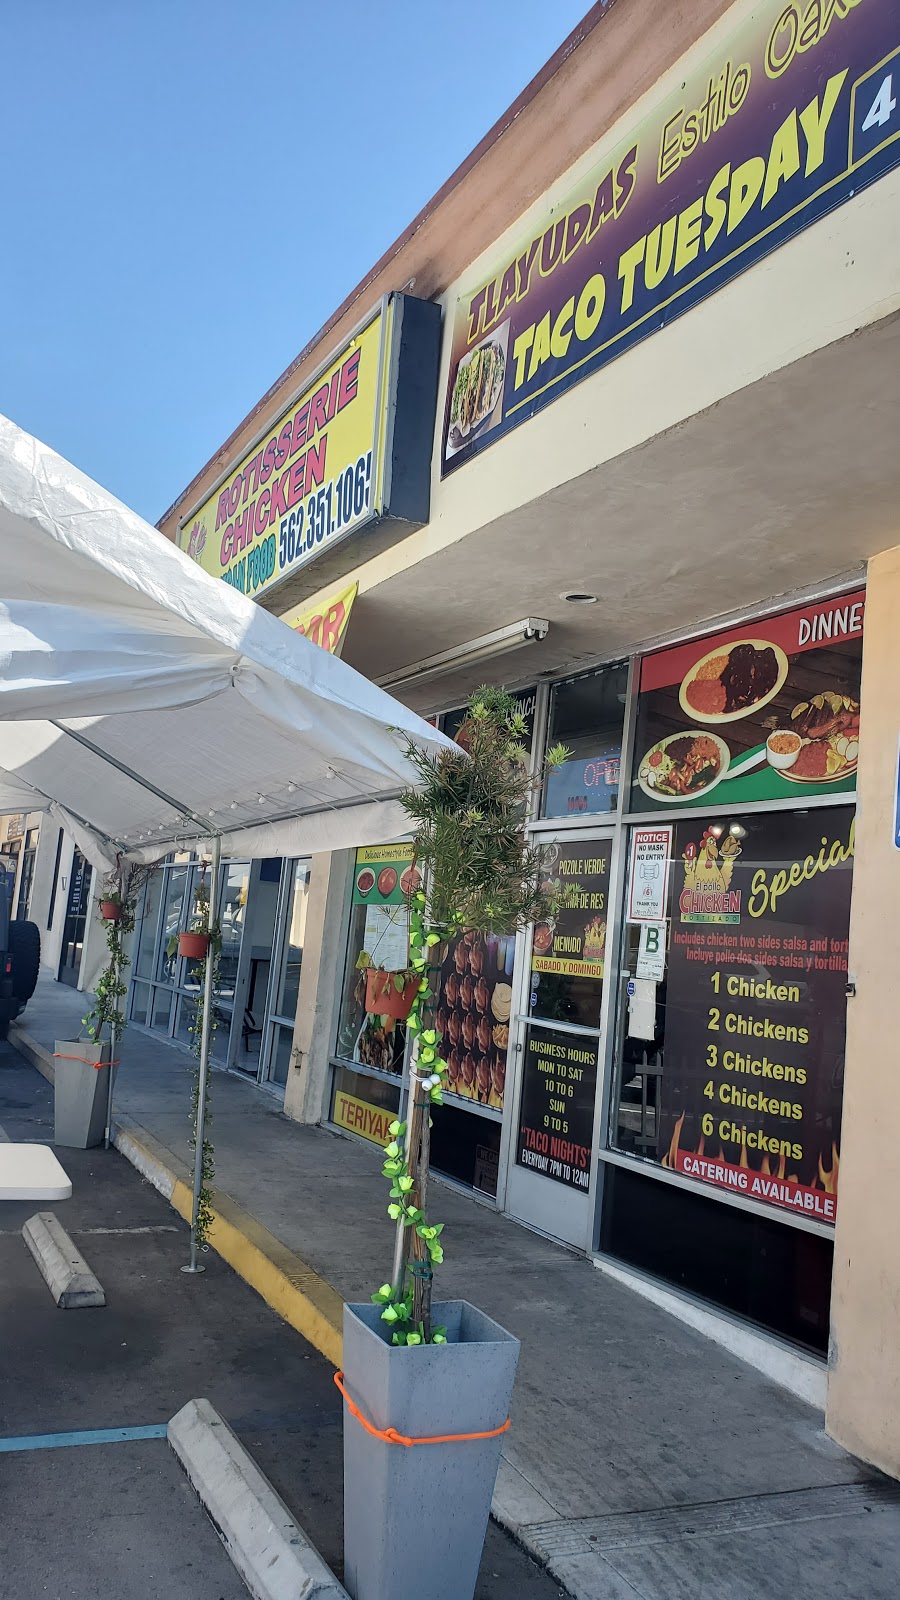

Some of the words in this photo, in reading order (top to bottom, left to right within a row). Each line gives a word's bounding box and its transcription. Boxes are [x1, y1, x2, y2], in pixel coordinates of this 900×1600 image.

[467, 144, 638, 345] TLAYUDAS
[657, 57, 751, 183] Estilo
[513, 273, 606, 391] TACO
[617, 68, 849, 314] TUESDAY
[215, 346, 362, 533] ROTISSERIE
[220, 432, 328, 567] CHICKEN
[246, 533, 275, 594] FOOD
[798, 602, 866, 646] DINNE
[637, 833, 668, 842] NOTICE
[558, 859, 583, 876] POZOLE
[584, 858, 606, 875] VERDE
[645, 853, 665, 861] ENTRY
[580, 893, 590, 908] DE
[590, 893, 604, 909] RES
[679, 888, 742, 914] CHICKEN
[553, 937, 582, 954] MENUDO
[645, 927, 659, 953] B
[674, 931, 705, 945] Includes
[706, 932, 738, 947] chicken
[740, 935, 756, 948] two
[757, 935, 781, 950] sides
[782, 936, 807, 951] salsa
[810, 937, 828, 952] and
[535, 959, 561, 971] SABADO
[563, 962, 567, 972] Y
[568, 962, 601, 976] DOMINGO
[686, 947, 714, 965] Incluye
[715, 949, 735, 965] pollo
[736, 950, 752, 964] dos
[754, 951, 777, 966] sides
[779, 952, 804, 968] salsa
[805, 957, 812, 973] y
[711, 971, 720, 994] 1
[727, 976, 800, 1003] Chicken
[708, 1007, 720, 1031] 2
[725, 1012, 809, 1044] Chickens
[529, 1039, 566, 1059] BUSINESS
[567, 1048, 596, 1066] HOURS
[706, 1044, 718, 1068] 3
[723, 1050, 807, 1085] Chickens
[537, 1059, 555, 1075] MON
[557, 1063, 567, 1077] TO
[568, 1066, 584, 1082] SAT
[544, 1079, 554, 1092] 10
[556, 1081, 567, 1095] TO
[567, 1085, 574, 1098] 6
[704, 1080, 714, 1100] 4
[719, 1083, 803, 1120] Chickens
[340, 1097, 396, 1142] TERIYAK
[549, 1098, 565, 1114] SUN
[543, 1114, 549, 1127] 9
[551, 1117, 561, 1131] TO
[562, 1120, 569, 1134] 5
[701, 1113, 714, 1136] 6
[719, 1121, 803, 1160] Chickens
[521, 1148, 549, 1174] EVERYDAY
[549, 1159, 562, 1178] 7PM
[562, 1165, 571, 1181] TO
[572, 1167, 589, 1188] 12AM
[683, 1156, 748, 1189] CATERING
[751, 1178, 834, 1217] AVAILABLE
